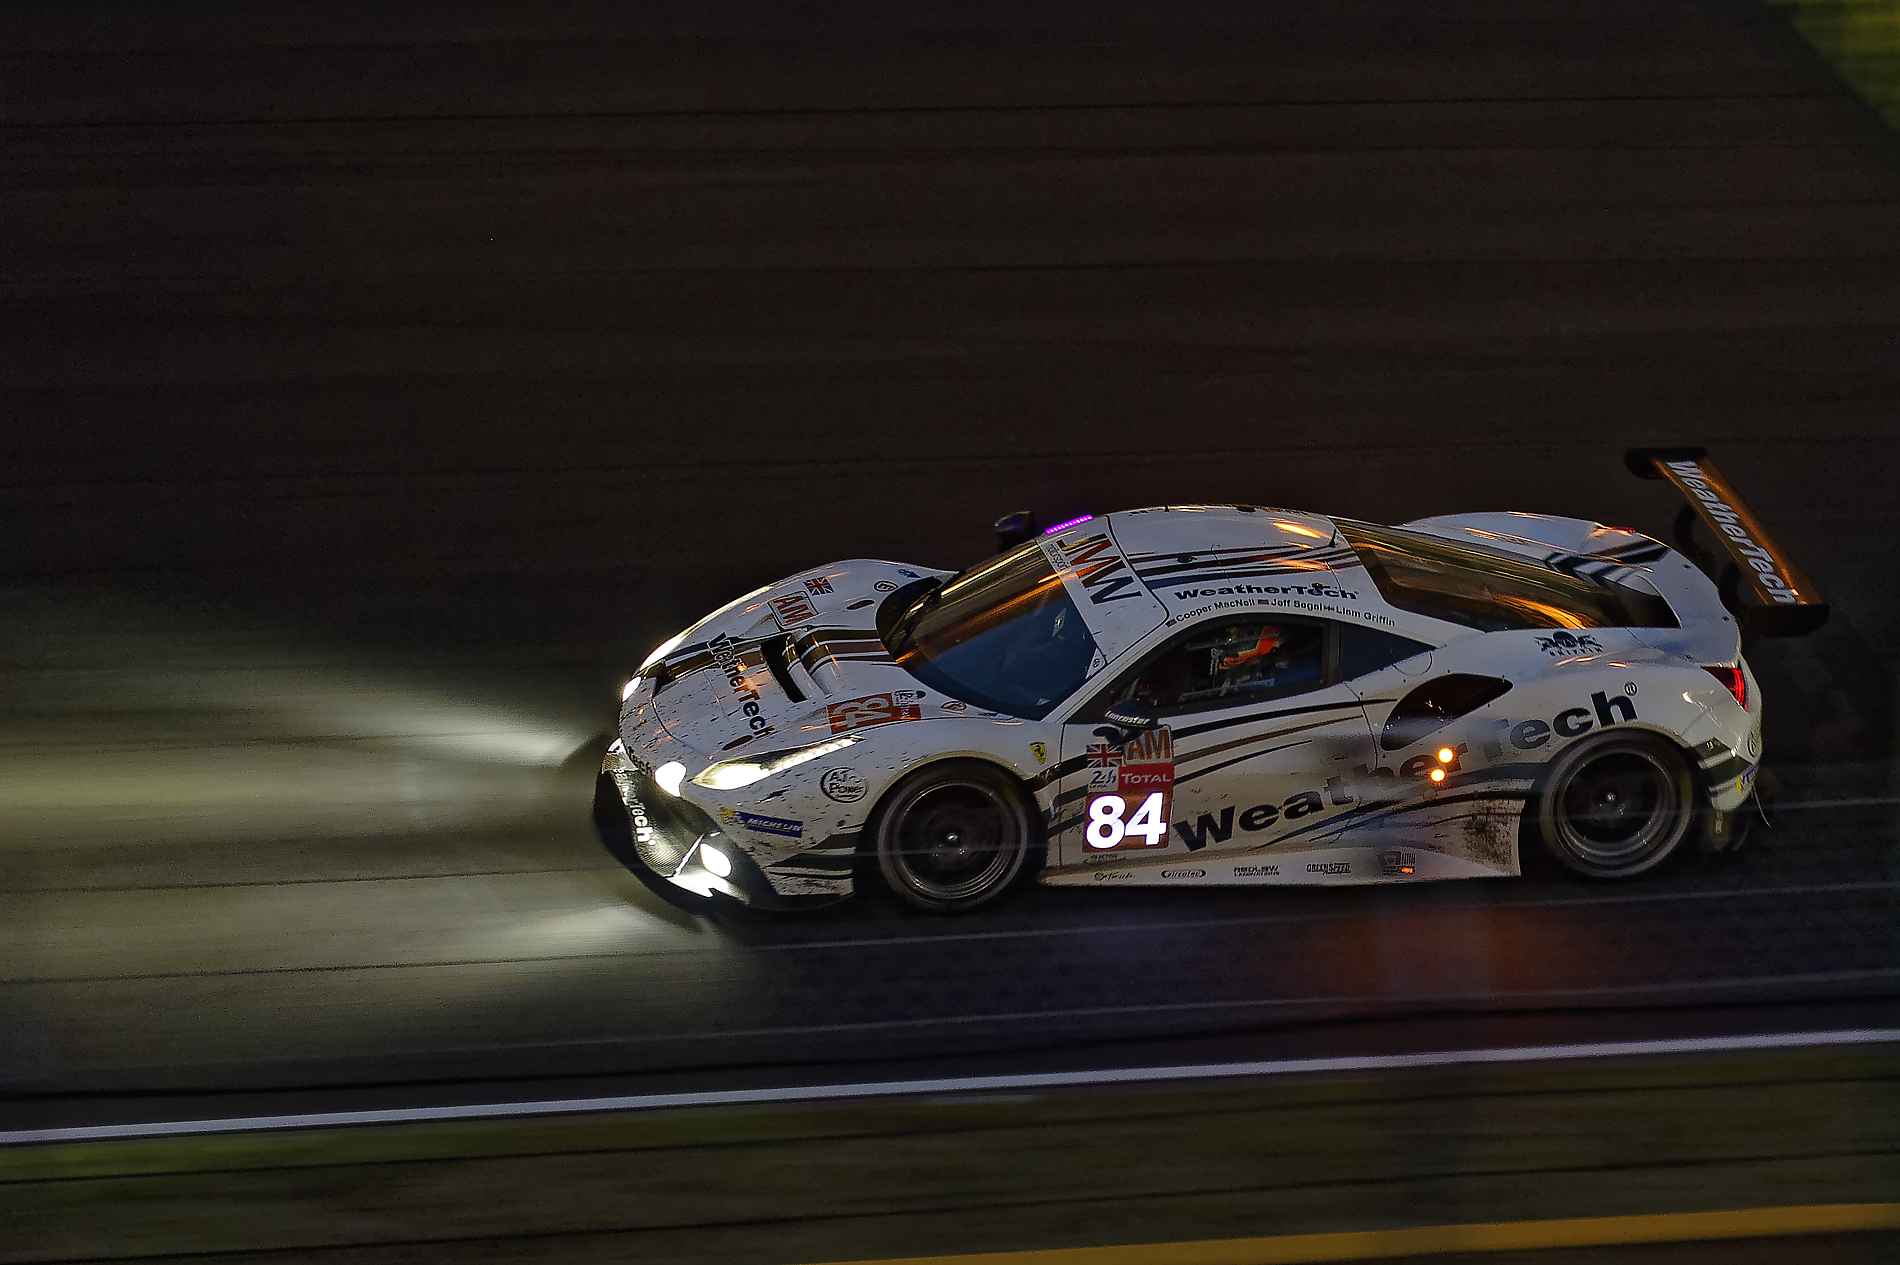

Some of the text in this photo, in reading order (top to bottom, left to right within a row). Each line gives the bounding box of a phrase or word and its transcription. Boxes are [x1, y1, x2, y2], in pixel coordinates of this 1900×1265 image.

[1667, 461, 1797, 604] WeatherTech
[1174, 583, 1358, 600] WeatherTech
[1176, 605, 1212, 622] Cooper
[1086, 792, 1167, 849] 84
